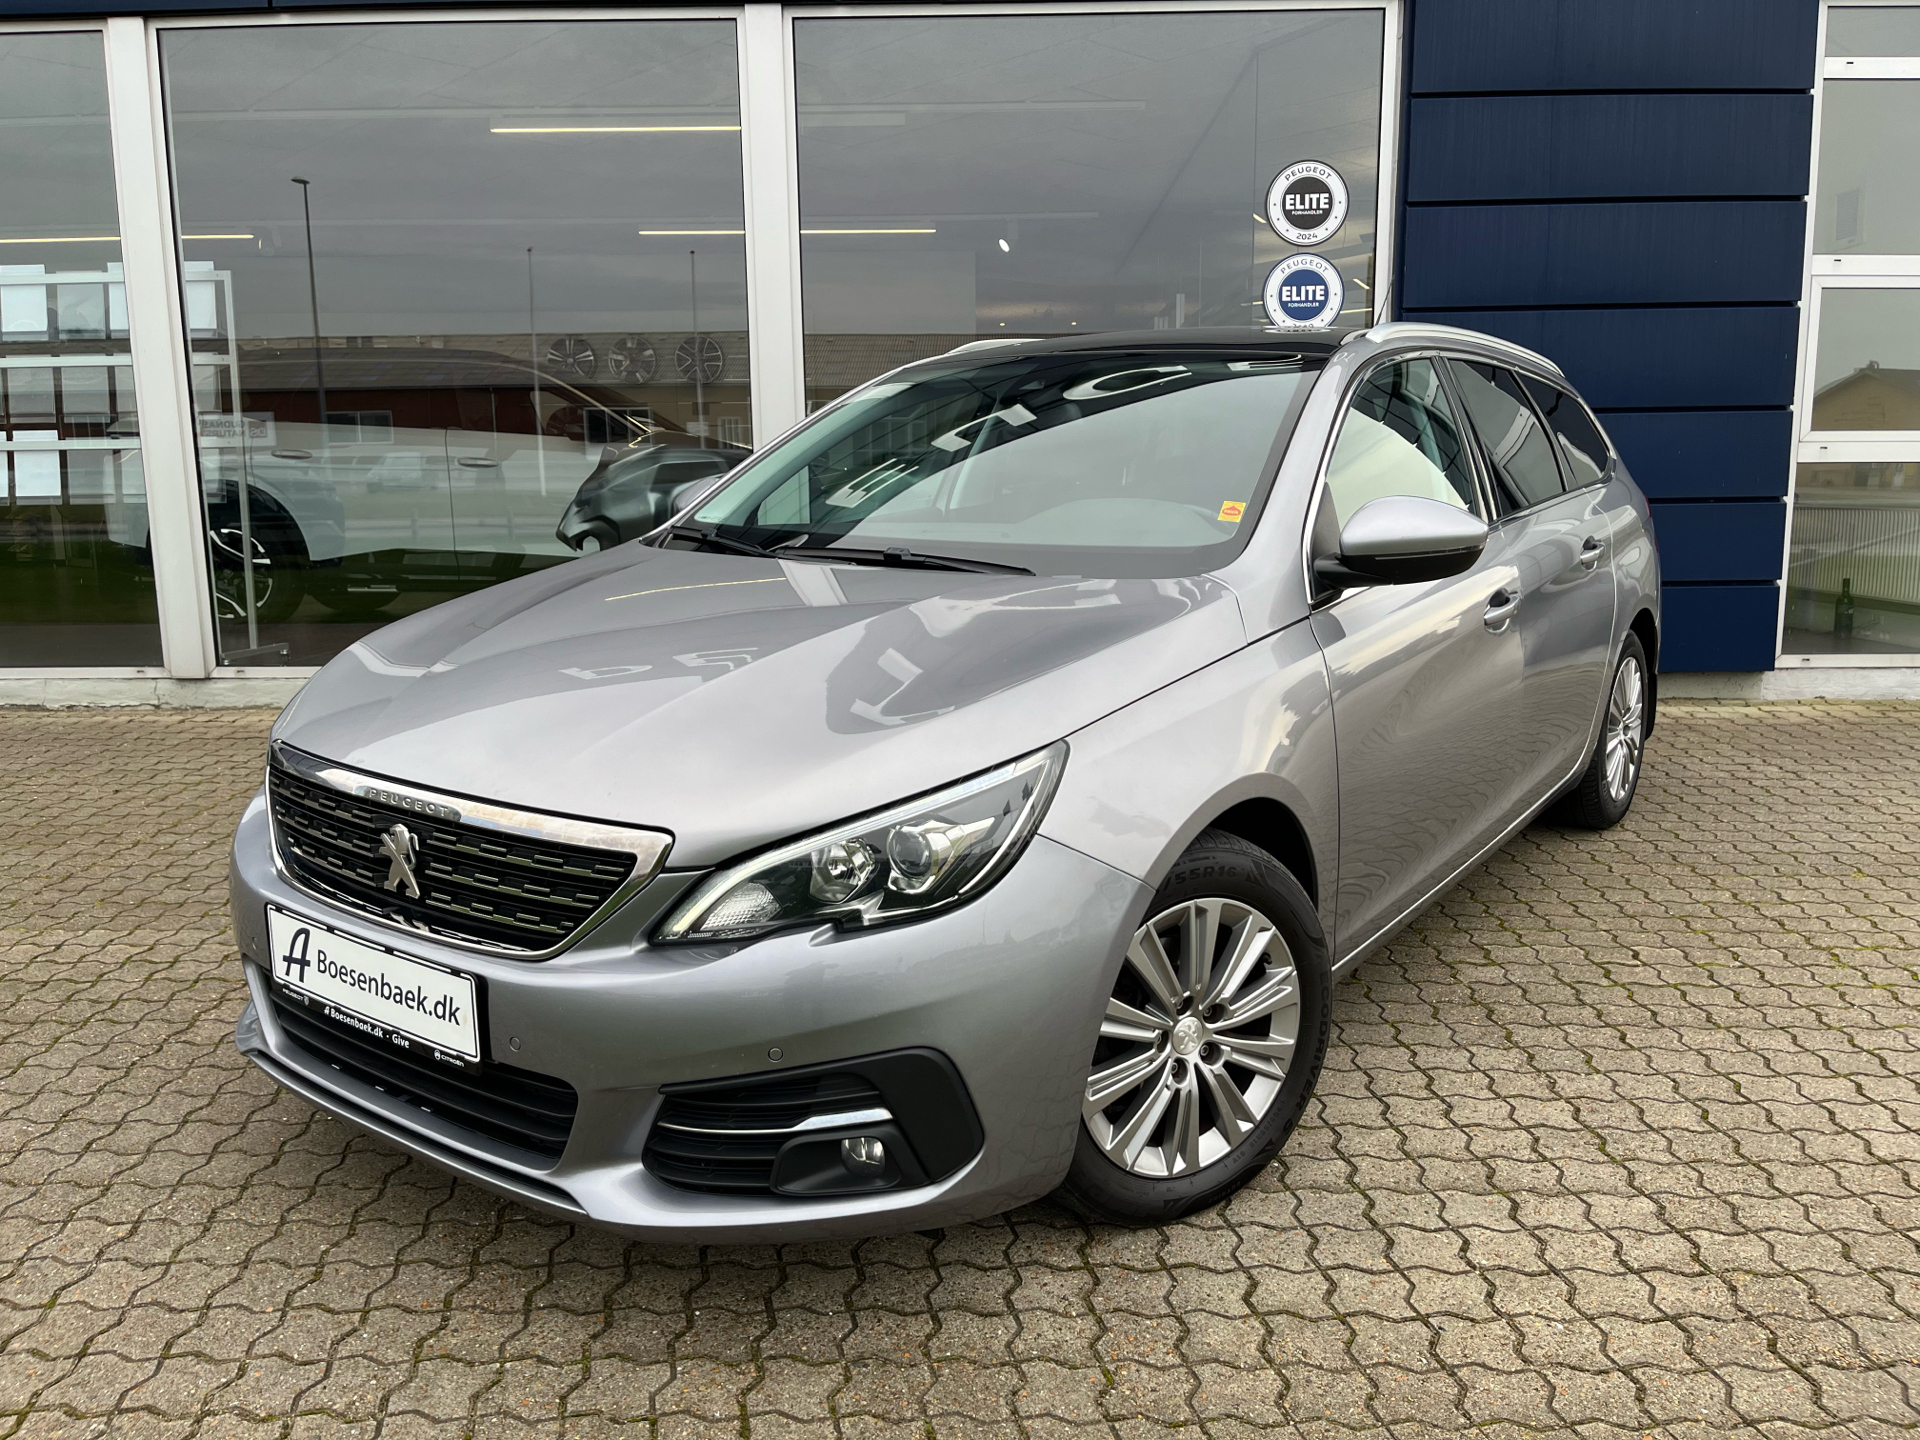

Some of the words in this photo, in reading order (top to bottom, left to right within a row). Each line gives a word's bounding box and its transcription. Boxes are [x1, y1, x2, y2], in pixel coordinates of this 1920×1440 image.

[1284, 166, 1332, 181] PEUGEOT
[1285, 193, 1330, 210] ELITE
[1296, 232, 1318, 241] 2024
[1280, 258, 1329, 274] PEUGEOT
[1281, 285, 1325, 302] ELITE
[369, 788, 449, 817] PEUGEOT
[317, 949, 461, 1027] Boesenbaek.dk
[330, 1008, 384, 1038] Boesenbaek.dk
[391, 1034, 410, 1049] Give
